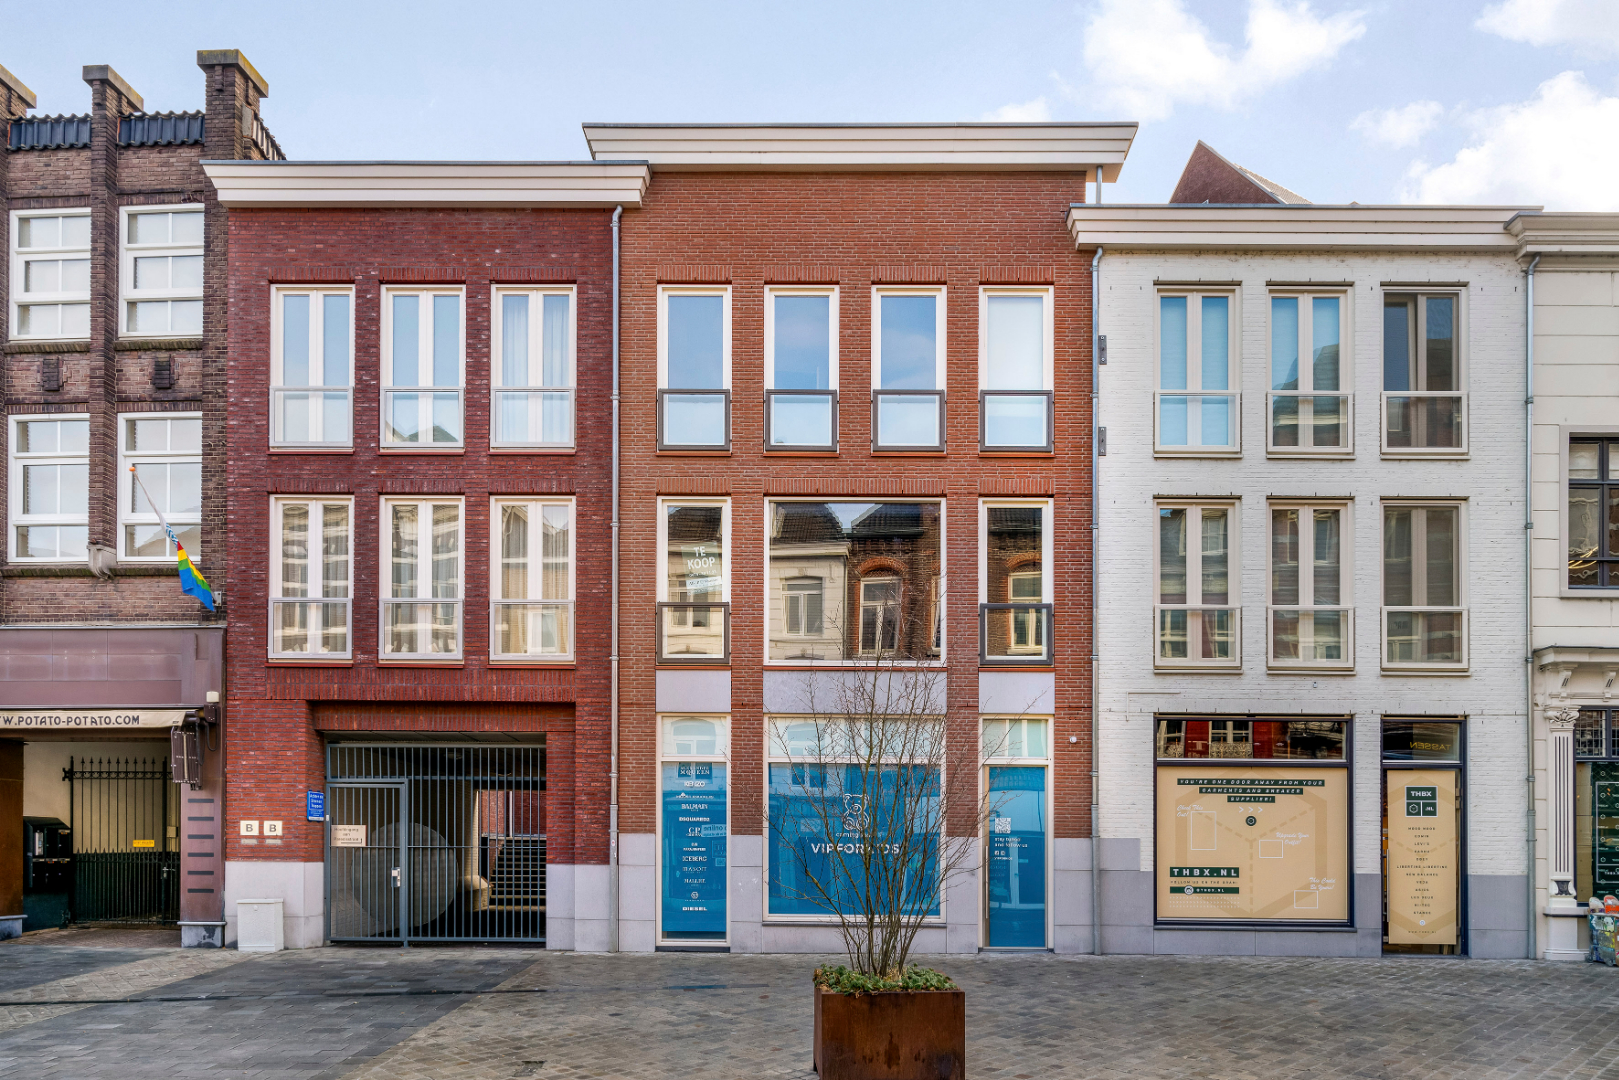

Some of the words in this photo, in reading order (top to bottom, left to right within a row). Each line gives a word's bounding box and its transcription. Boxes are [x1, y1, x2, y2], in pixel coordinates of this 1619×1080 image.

[693, 546, 706, 557] TE
[687, 556, 716, 570] KOOP
[0, 715, 140, 726] W.POTATO-POTATO.COM
[245, 823, 254, 833] B
[269, 823, 277, 833] B
[1172, 868, 1238, 877] THBX.NL
